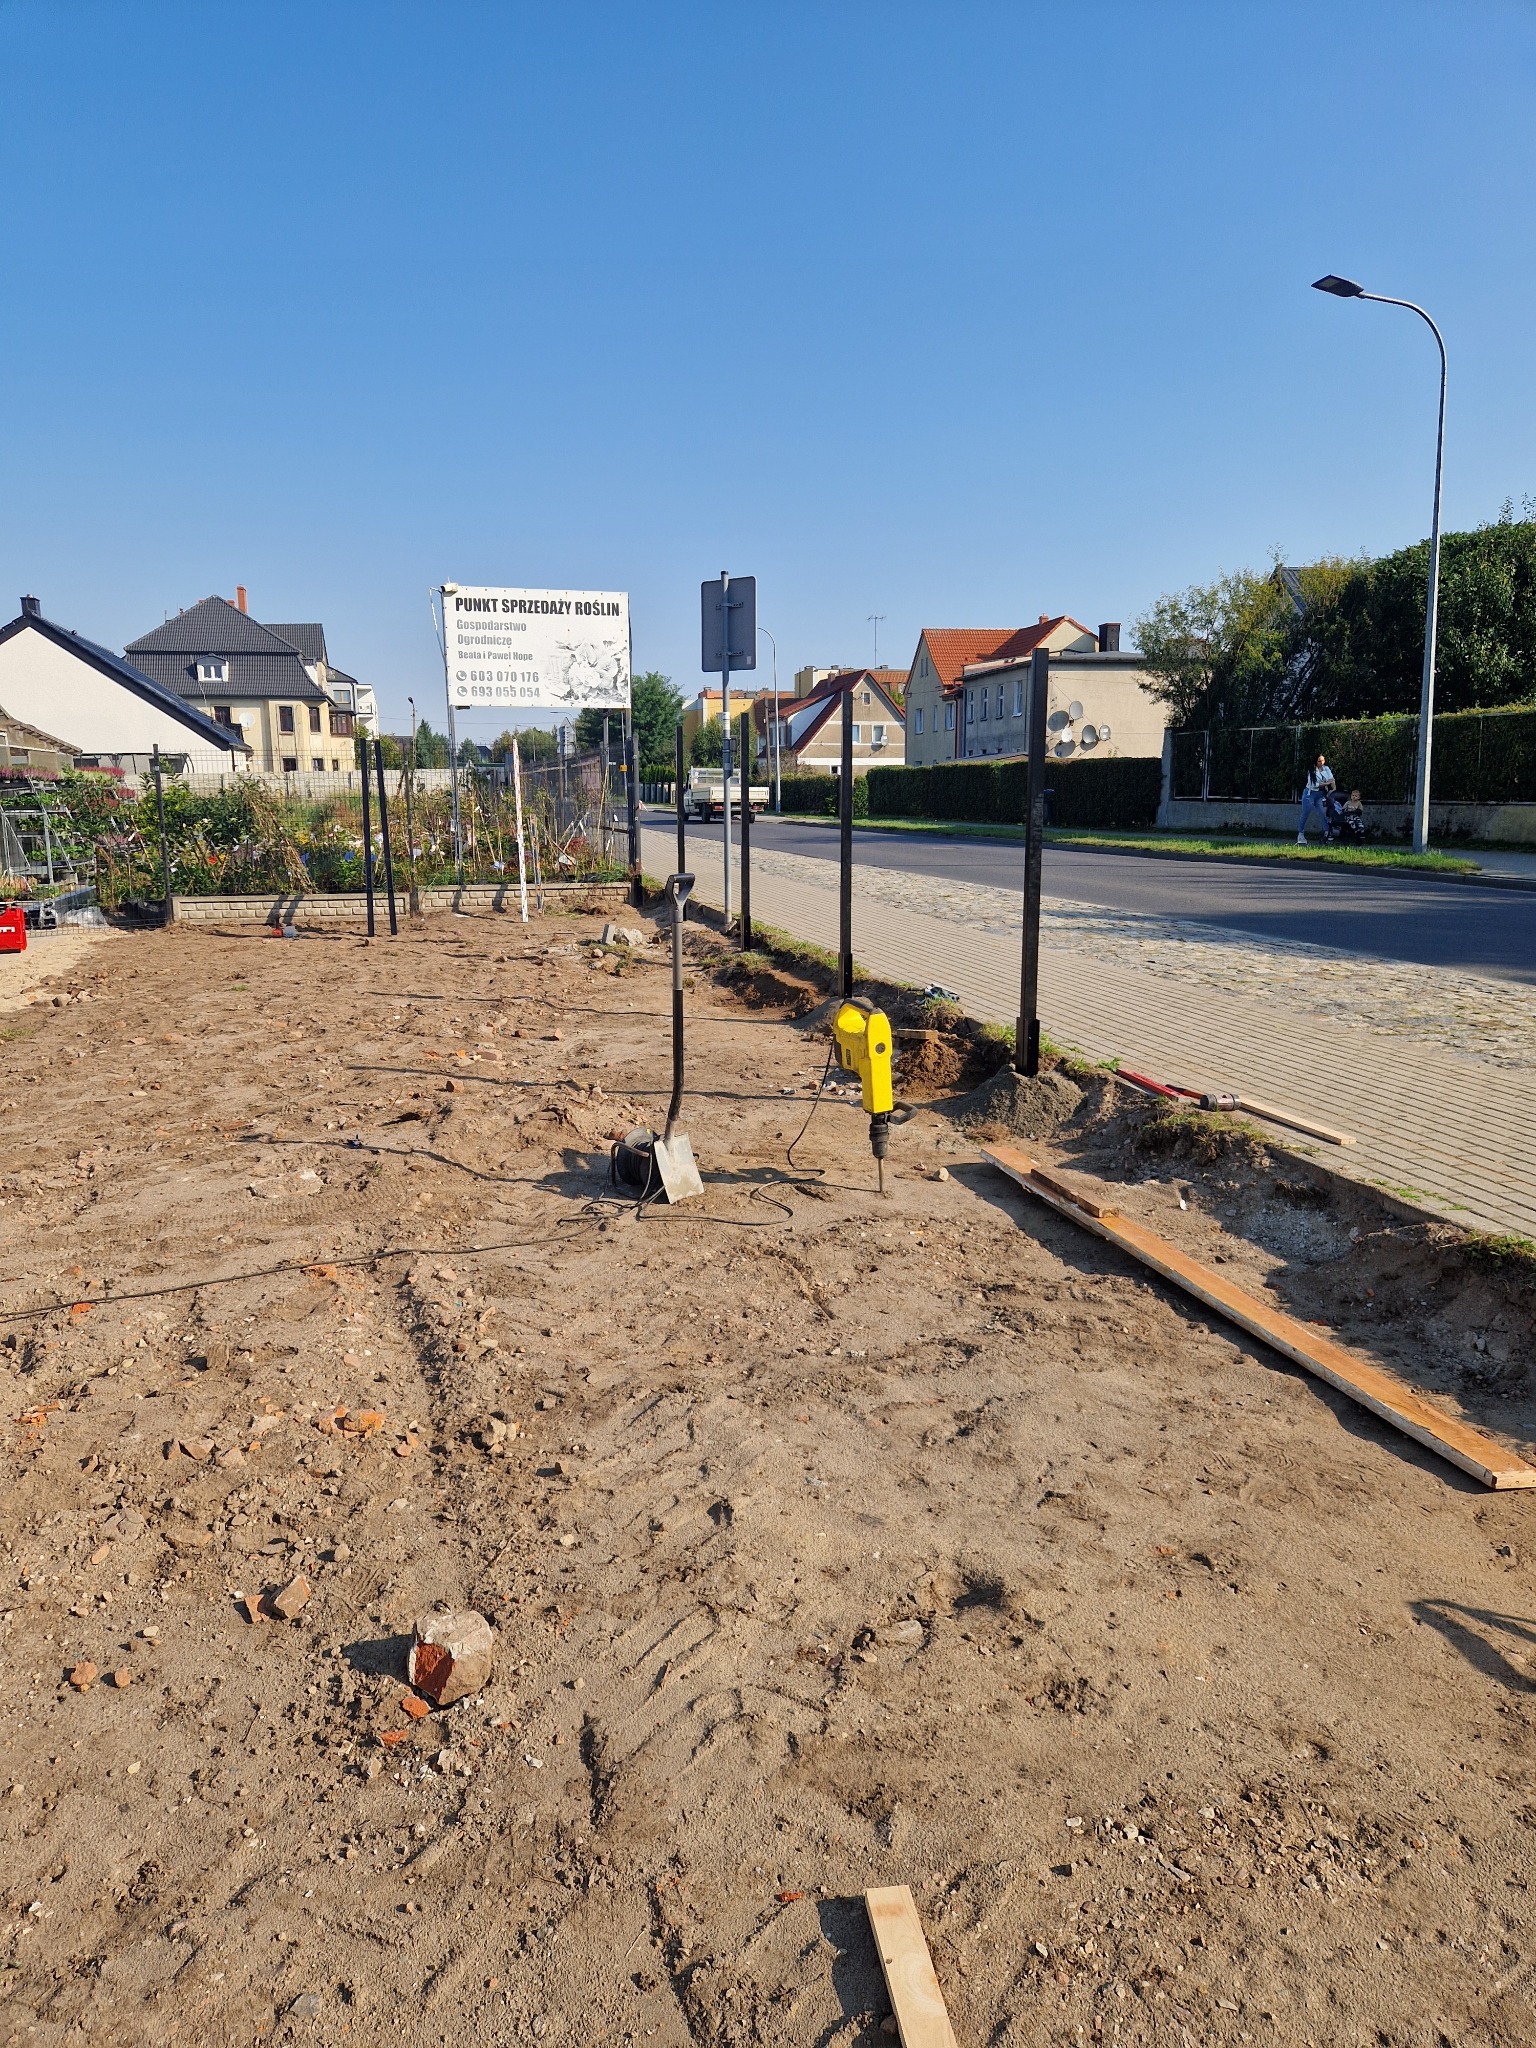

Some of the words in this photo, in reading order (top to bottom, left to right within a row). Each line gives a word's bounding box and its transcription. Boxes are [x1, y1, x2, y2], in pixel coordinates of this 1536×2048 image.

[455, 598, 498, 612] PUNKT
[501, 598, 572, 615] SPRZEDAŻY
[575, 600, 620, 616] ROŚLIN
[457, 619, 527, 631] Gospodarstwo
[458, 634, 512, 646] Ogrodnicze
[458, 650, 482, 660] Beata
[513, 652, 534, 661] Hope
[470, 670, 493, 682] 603
[497, 671, 518, 683] 070
[520, 671, 540, 683] 176
[471, 686, 493, 697] 693
[496, 686, 517, 698] 055
[520, 687, 541, 698] 054
